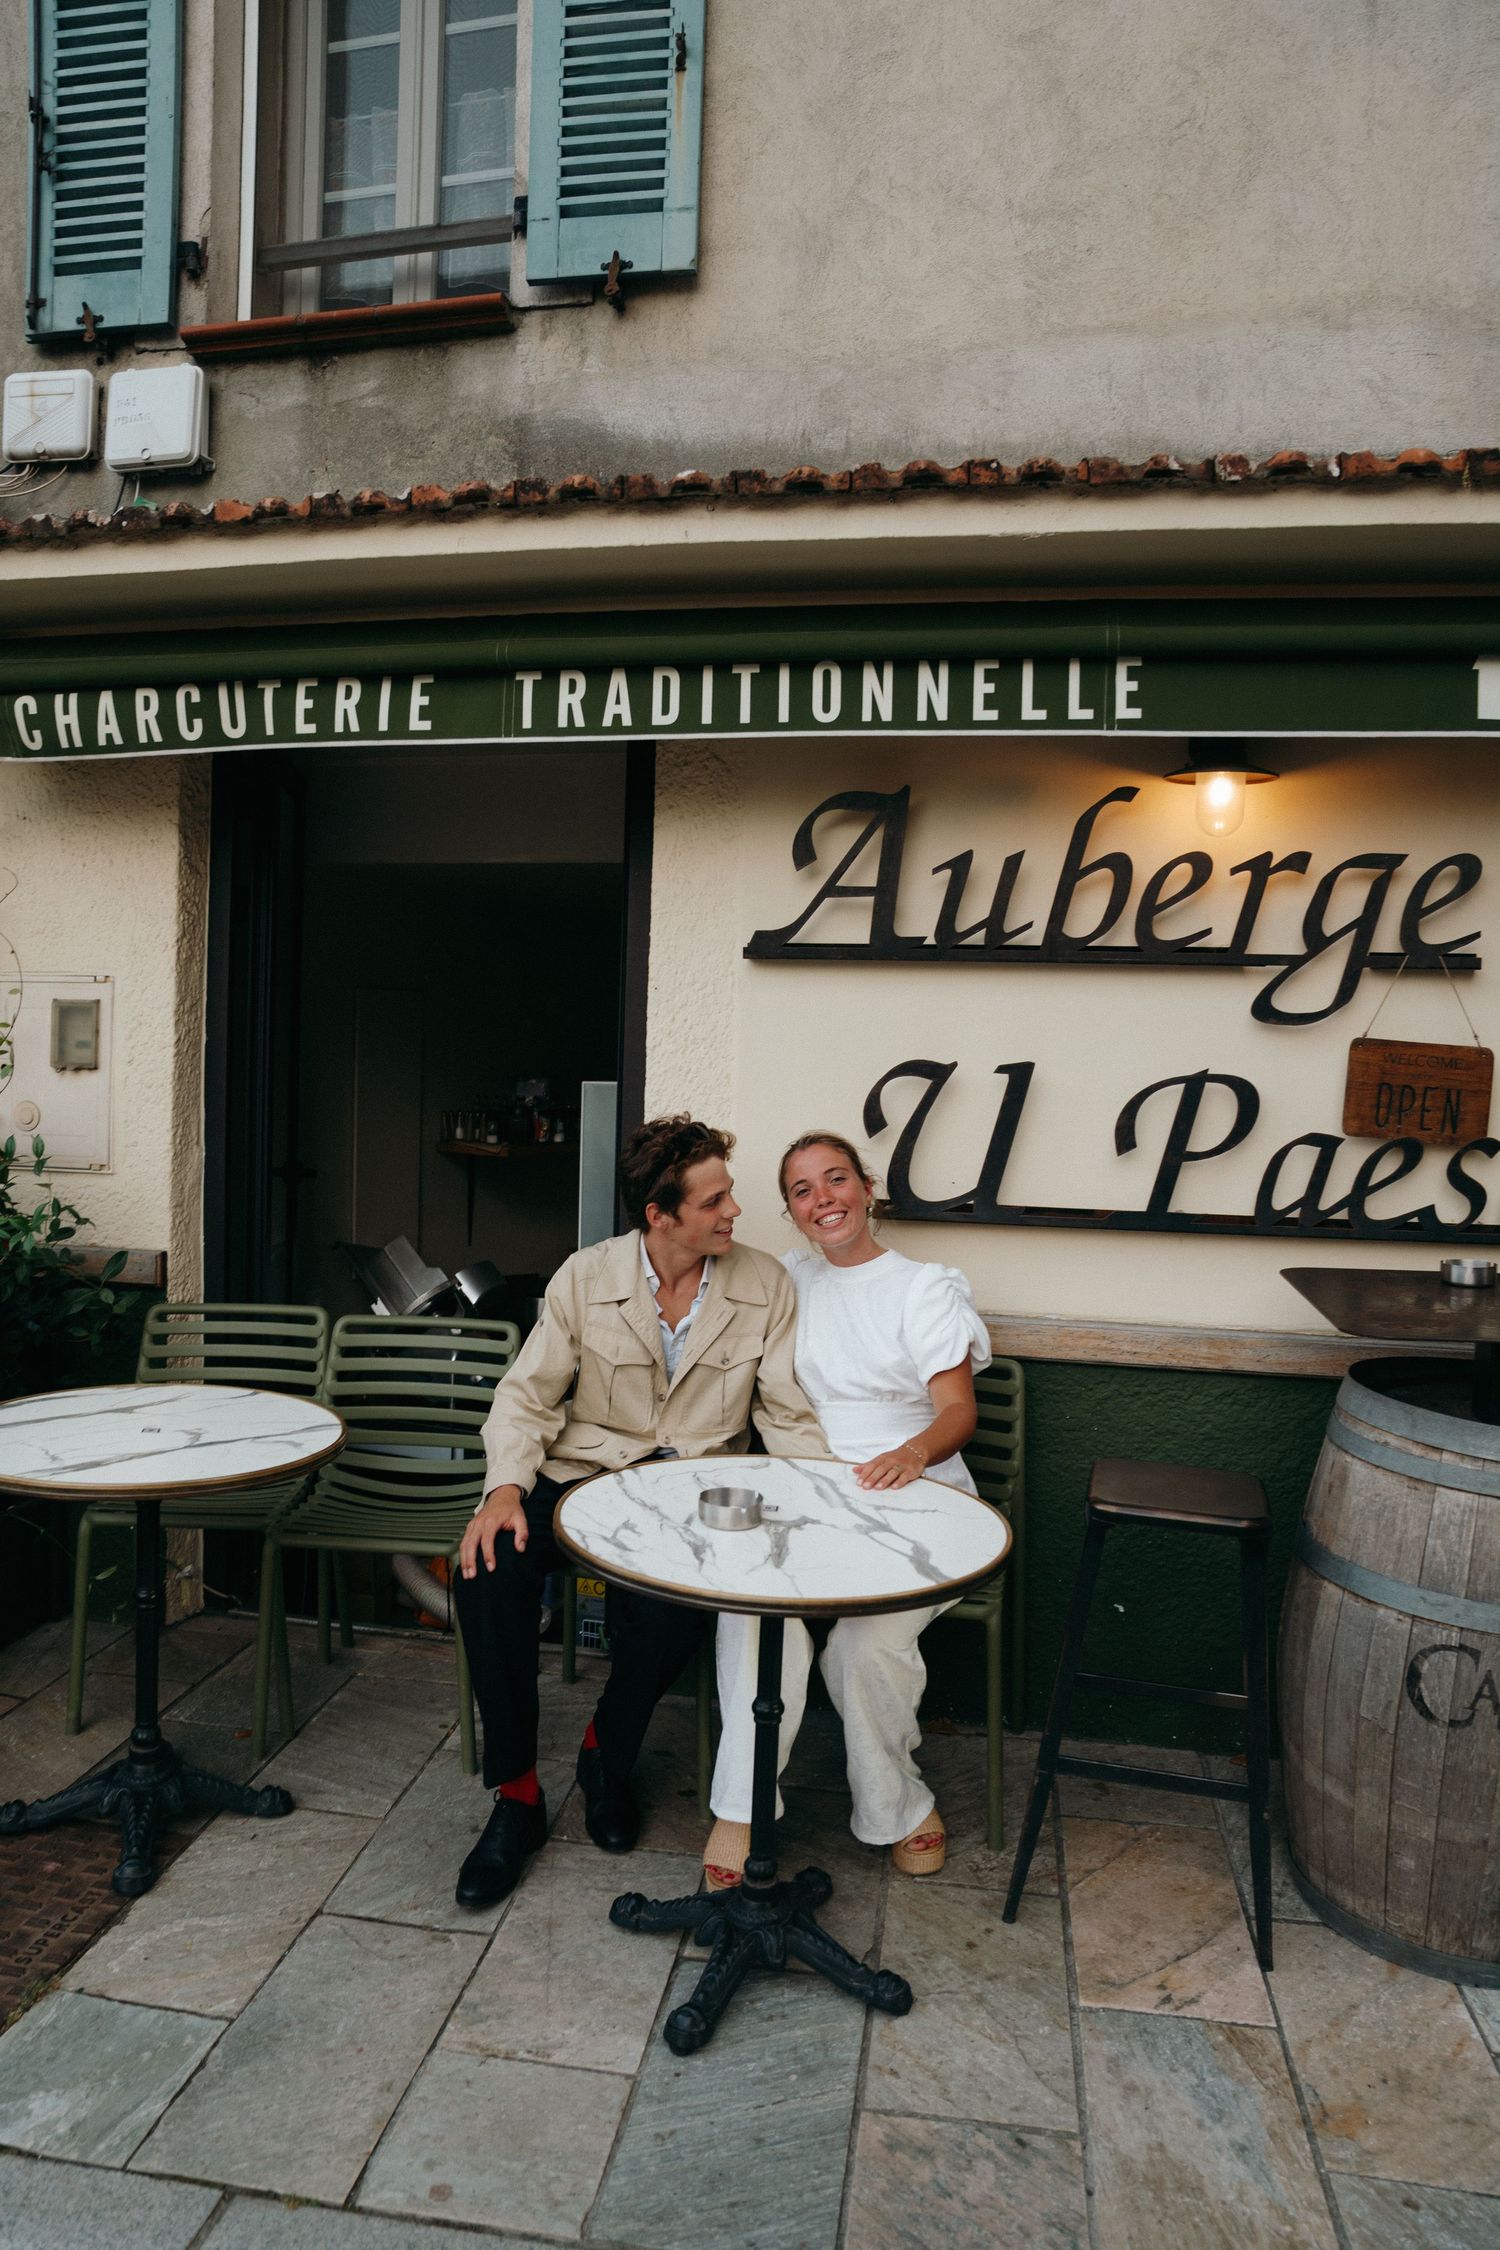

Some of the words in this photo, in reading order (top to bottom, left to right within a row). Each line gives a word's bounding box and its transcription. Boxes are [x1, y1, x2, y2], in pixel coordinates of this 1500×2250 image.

[14, 673, 435, 751] CHARCUTERIE
[514, 656, 1143, 730] TRADITIONNELLE
[748, 785, 1483, 1026] Auberge
[1383, 1052, 1466, 1071] WELCOME
[1375, 1082, 1463, 1135] OPEN
